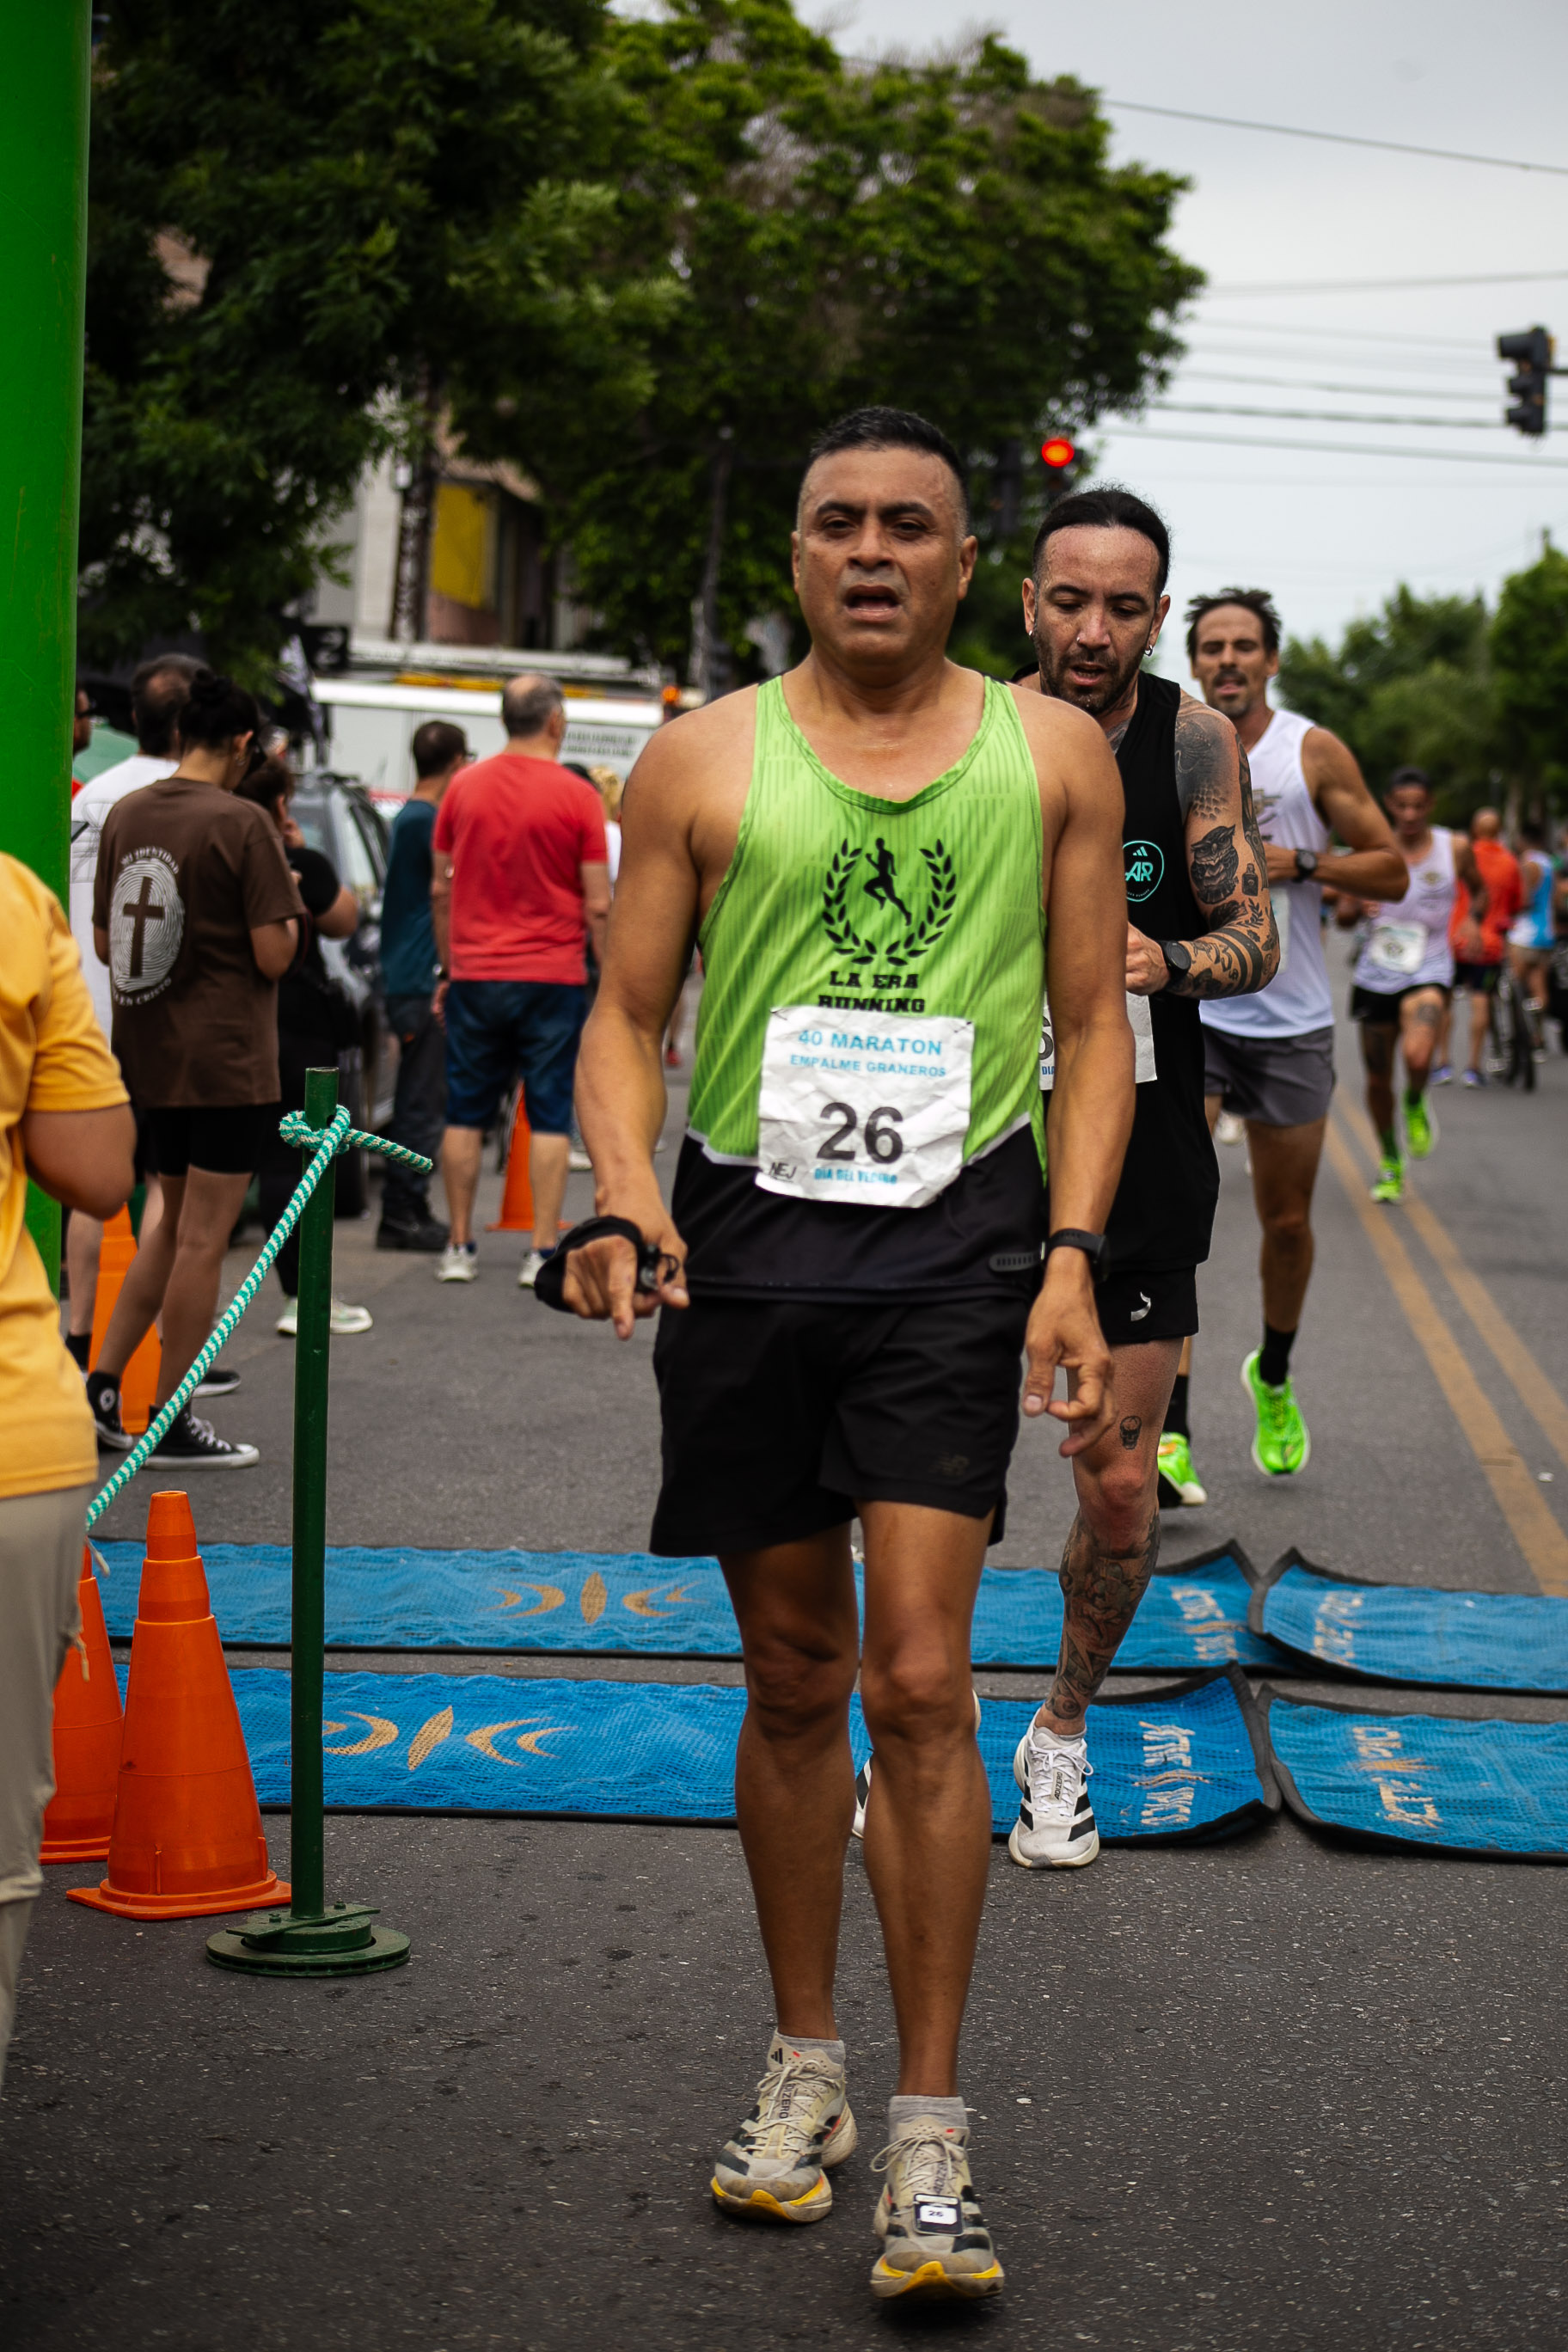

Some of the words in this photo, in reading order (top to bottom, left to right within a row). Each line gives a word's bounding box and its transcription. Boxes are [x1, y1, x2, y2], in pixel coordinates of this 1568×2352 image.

[1124, 861, 1153, 882] AR
[830, 971, 861, 988] LA
[873, 973, 919, 989] ERA
[818, 995, 925, 1013] RUNNING
[799, 1030, 823, 1046] 40
[831, 1033, 942, 1056] MARATON
[790, 1054, 861, 1071] EMPALME
[867, 1062, 946, 1077] GRANEROS
[817, 1102, 903, 1165] 26
[1054, 1771, 1063, 1800] ADIZERO
